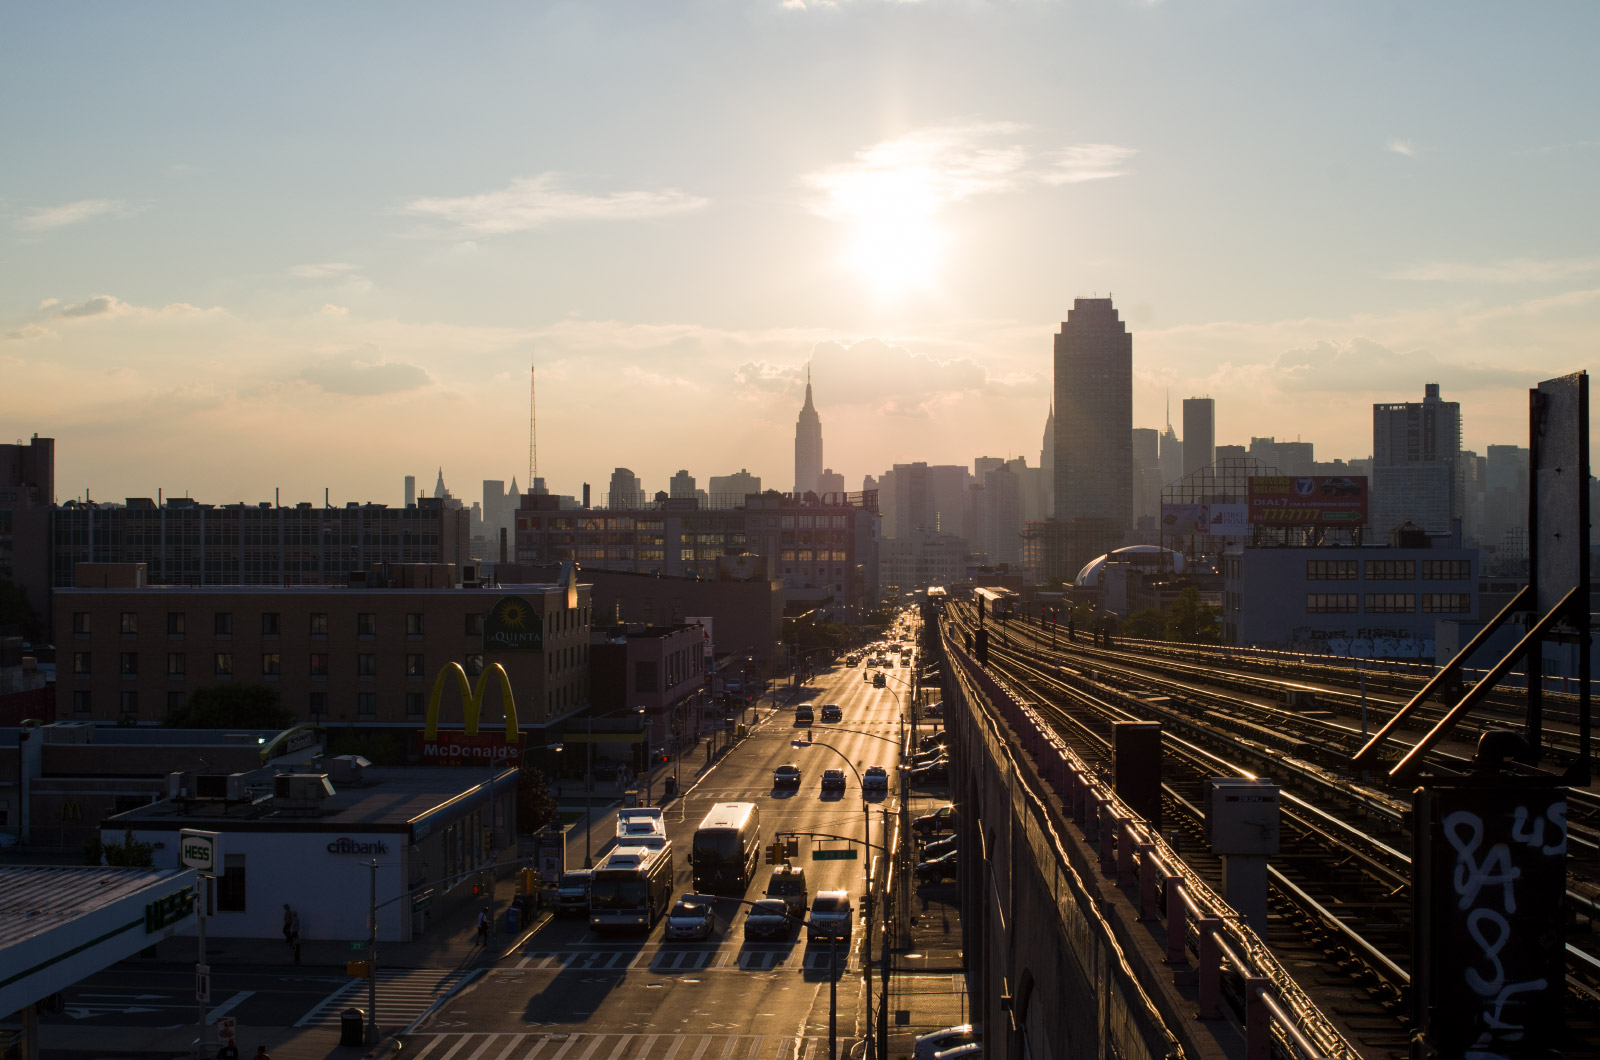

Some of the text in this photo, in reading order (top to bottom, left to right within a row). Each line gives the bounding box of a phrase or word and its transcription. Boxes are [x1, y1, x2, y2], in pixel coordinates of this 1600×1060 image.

[1253, 477, 1290, 485] DRIVERS
[1253, 486, 1290, 494] WELCOME
[1263, 508, 1320, 520] 777-7777
[495, 632, 541, 643] QUINTA
[423, 744, 520, 758] McDonald's
[184, 845, 209, 861] HESS
[326, 839, 387, 854] citibank
[146, 885, 194, 935] HESS
